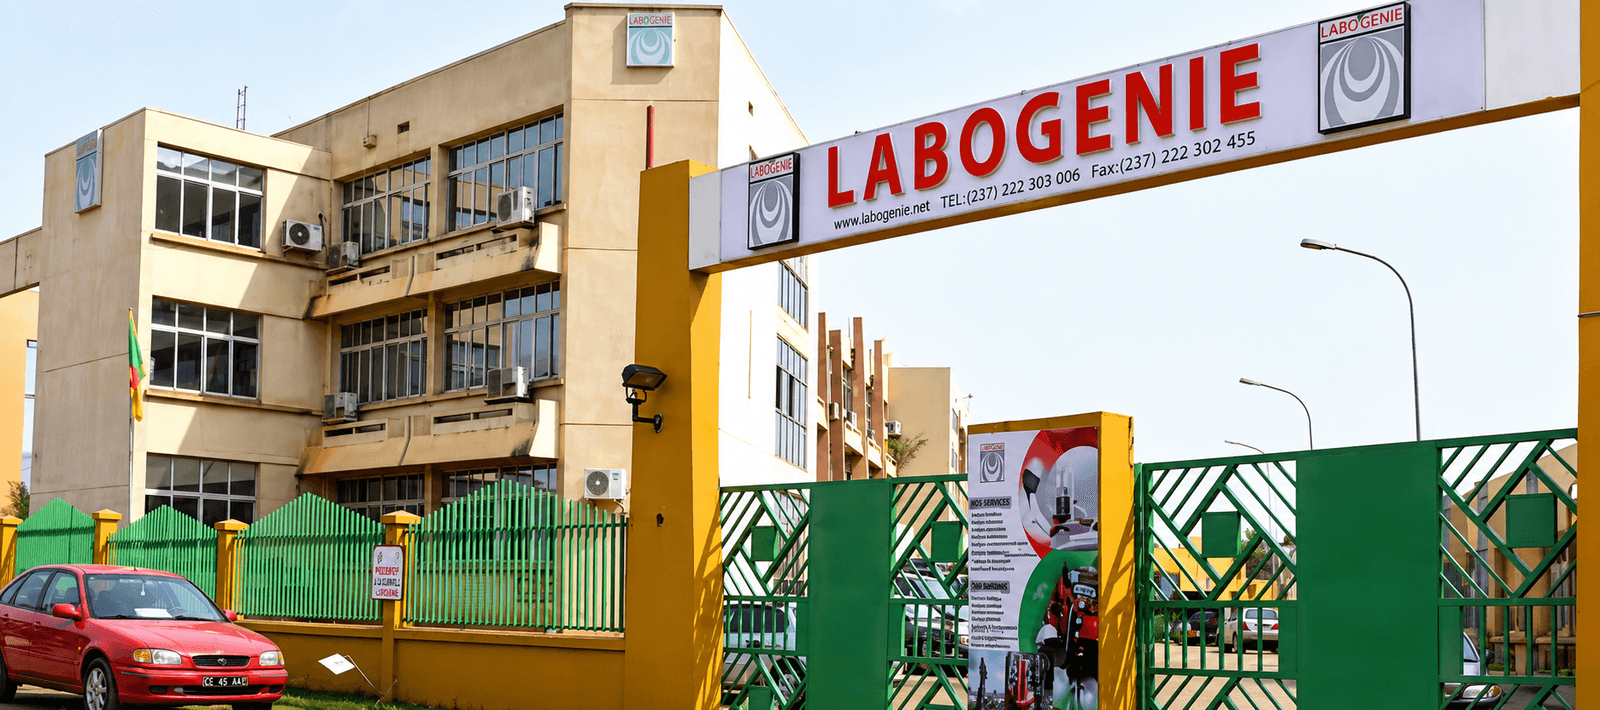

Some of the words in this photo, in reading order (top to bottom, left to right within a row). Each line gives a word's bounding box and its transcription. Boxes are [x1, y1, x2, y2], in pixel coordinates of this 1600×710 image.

[629, 16, 671, 25] LABOGENIE
[1320, 7, 1403, 39] LABOGENIE
[827, 43, 1262, 208] LABOGENIE
[750, 157, 793, 179] LABOGENIE
[833, 200, 931, 230] www.labogenie.net
[1002, 179, 1025, 197] 222
[1028, 174, 1052, 191] 303
[1055, 168, 1081, 185] 006
[1161, 145, 1188, 164] 222
[1193, 138, 1221, 157] 302
[1226, 130, 1256, 149] 455
[970, 499, 983, 507] NOS
[204, 677, 214, 686] CE
[218, 677, 228, 686] 45
